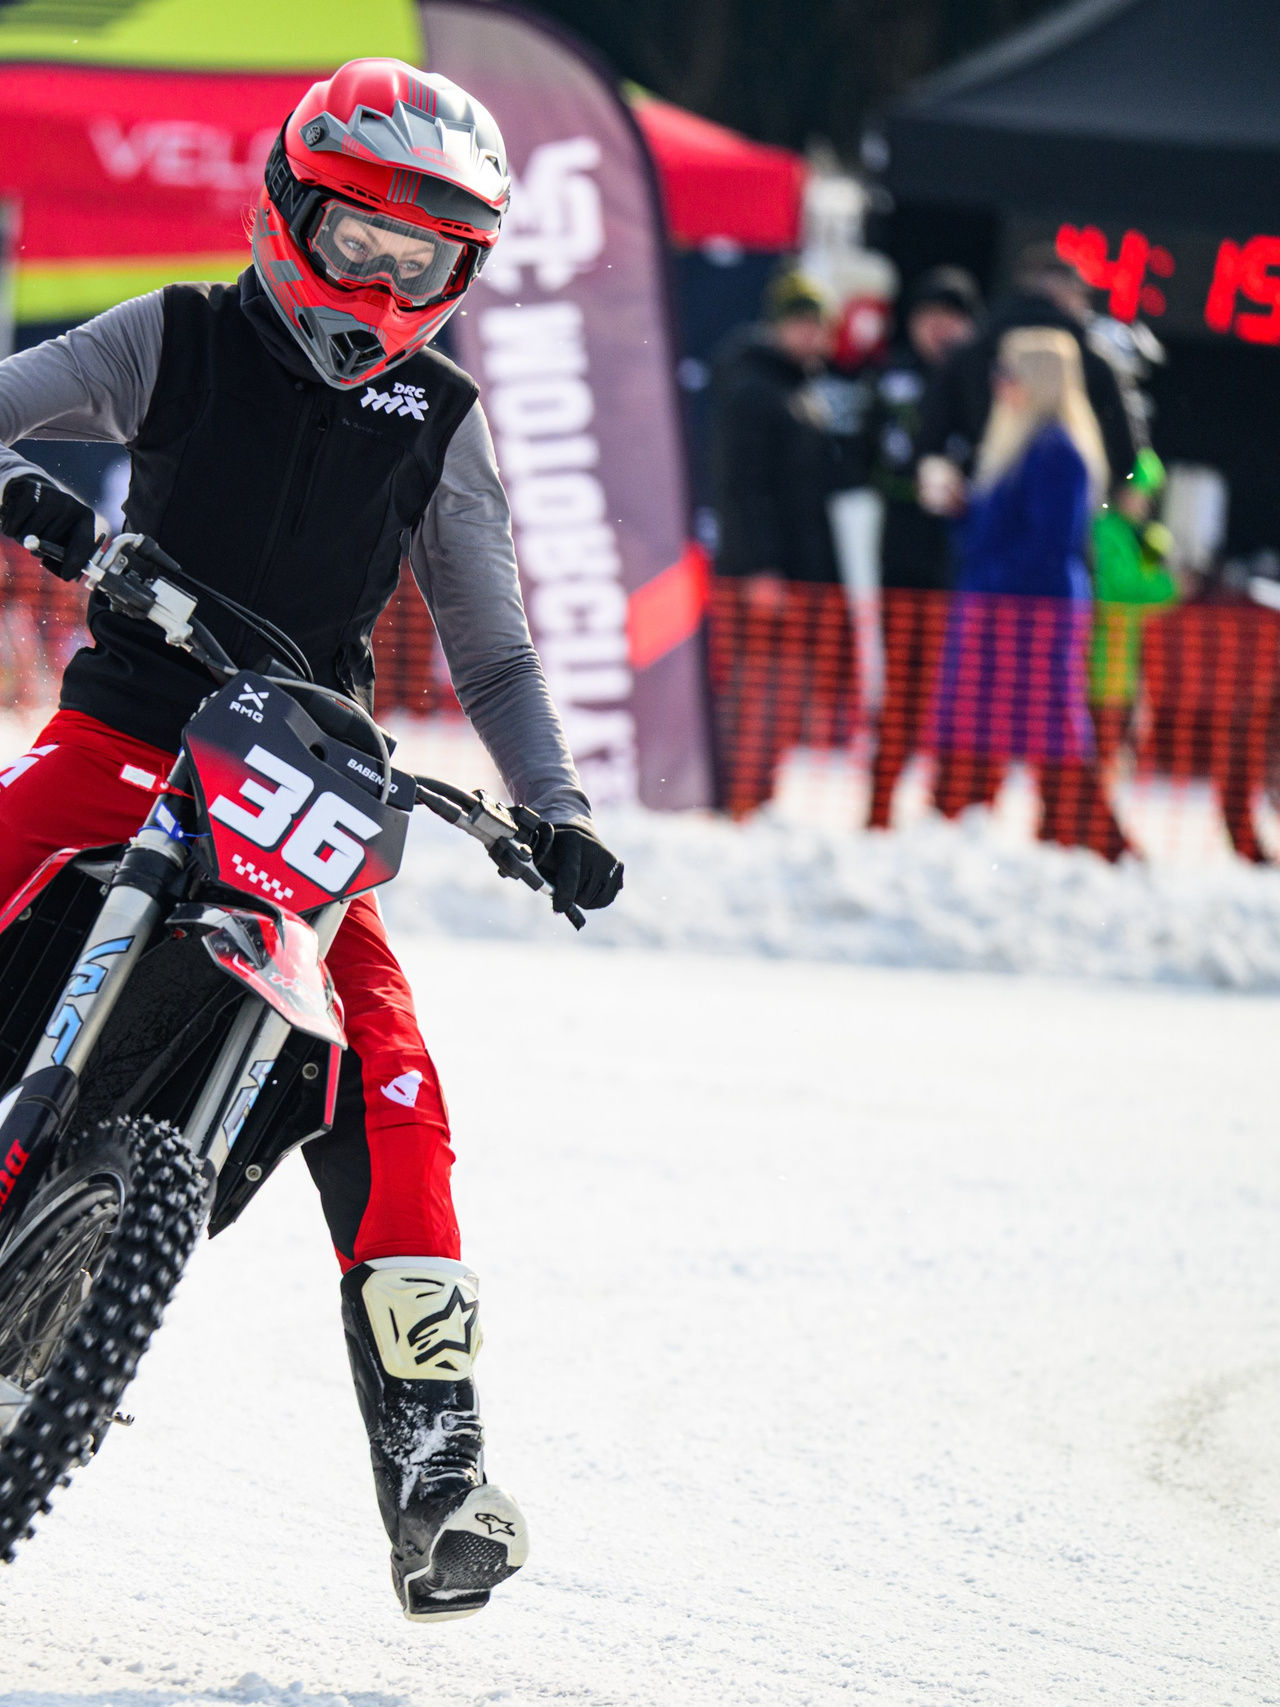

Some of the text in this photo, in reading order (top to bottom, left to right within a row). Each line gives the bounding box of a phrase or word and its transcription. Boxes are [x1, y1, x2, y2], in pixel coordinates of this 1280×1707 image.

[393, 382, 426, 399] DRC
[229, 701, 264, 723] RMG
[346, 758, 399, 795] BABENO
[208, 744, 383, 893] 36
